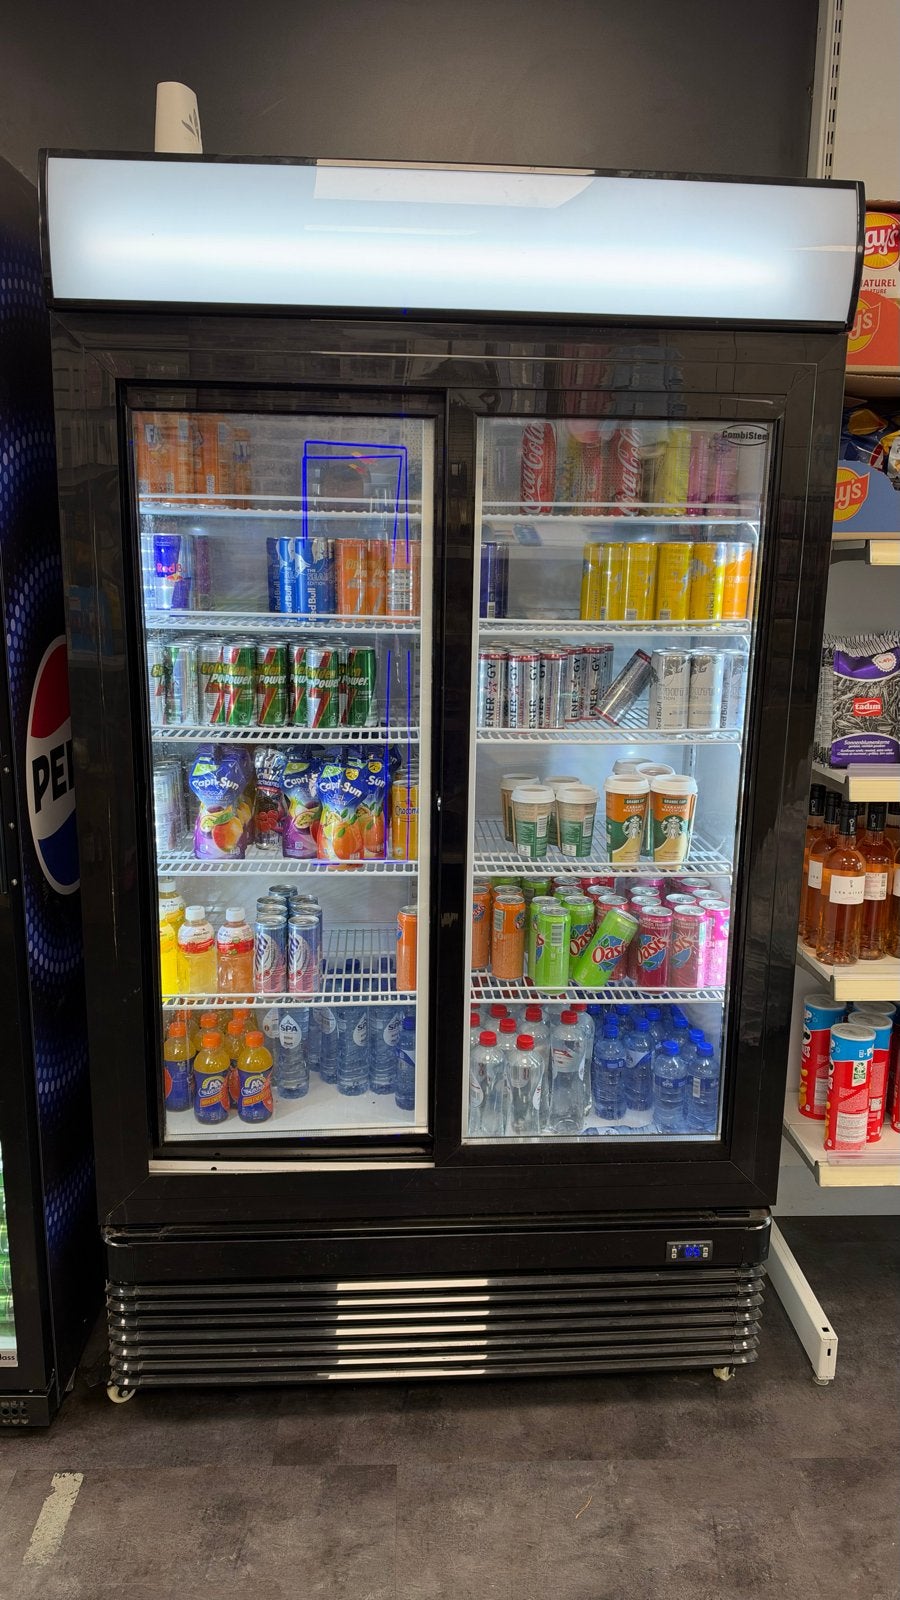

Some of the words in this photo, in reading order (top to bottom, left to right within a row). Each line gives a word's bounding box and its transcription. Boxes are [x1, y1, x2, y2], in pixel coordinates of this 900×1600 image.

[864, 224, 899, 255] ay's
[319, 780, 363, 798] Capri-Sun
[280, 1024, 298, 1032] SPA
